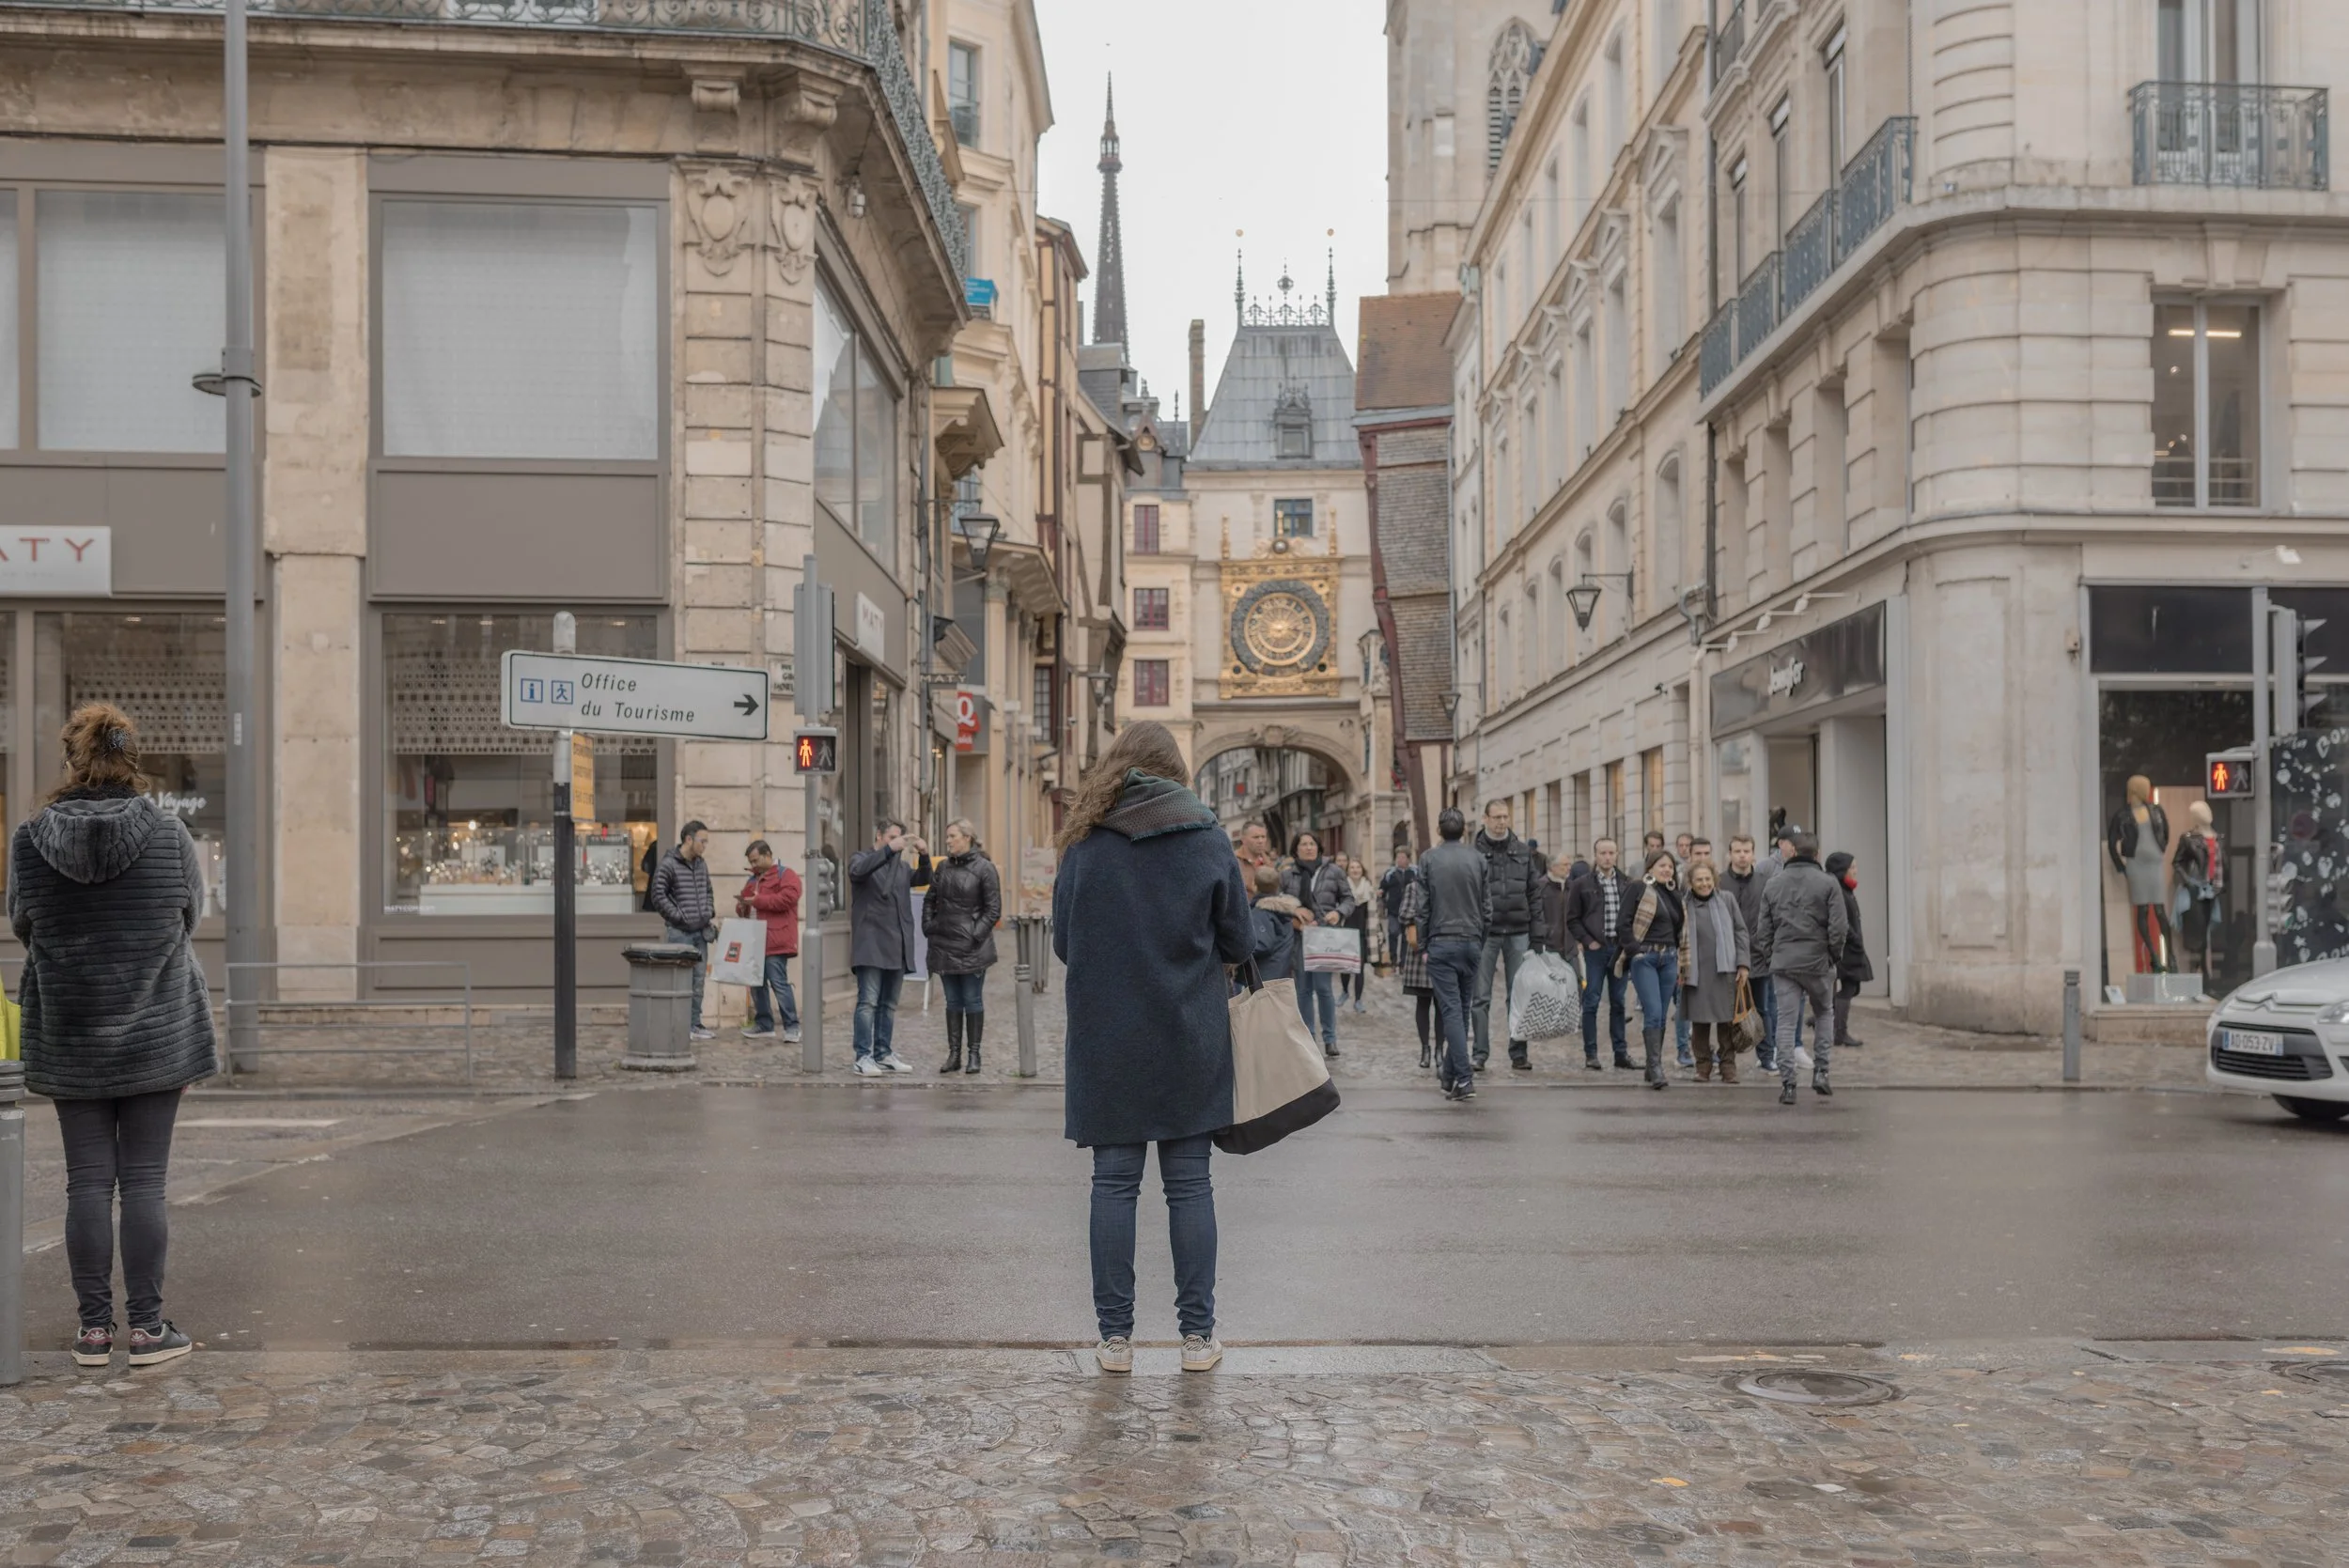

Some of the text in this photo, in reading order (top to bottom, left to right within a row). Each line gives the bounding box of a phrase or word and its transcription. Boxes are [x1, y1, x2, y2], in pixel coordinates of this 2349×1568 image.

[582, 673, 637, 692] Office
[920, 675, 967, 683] MATY
[581, 700, 695, 723] du Tourisme
